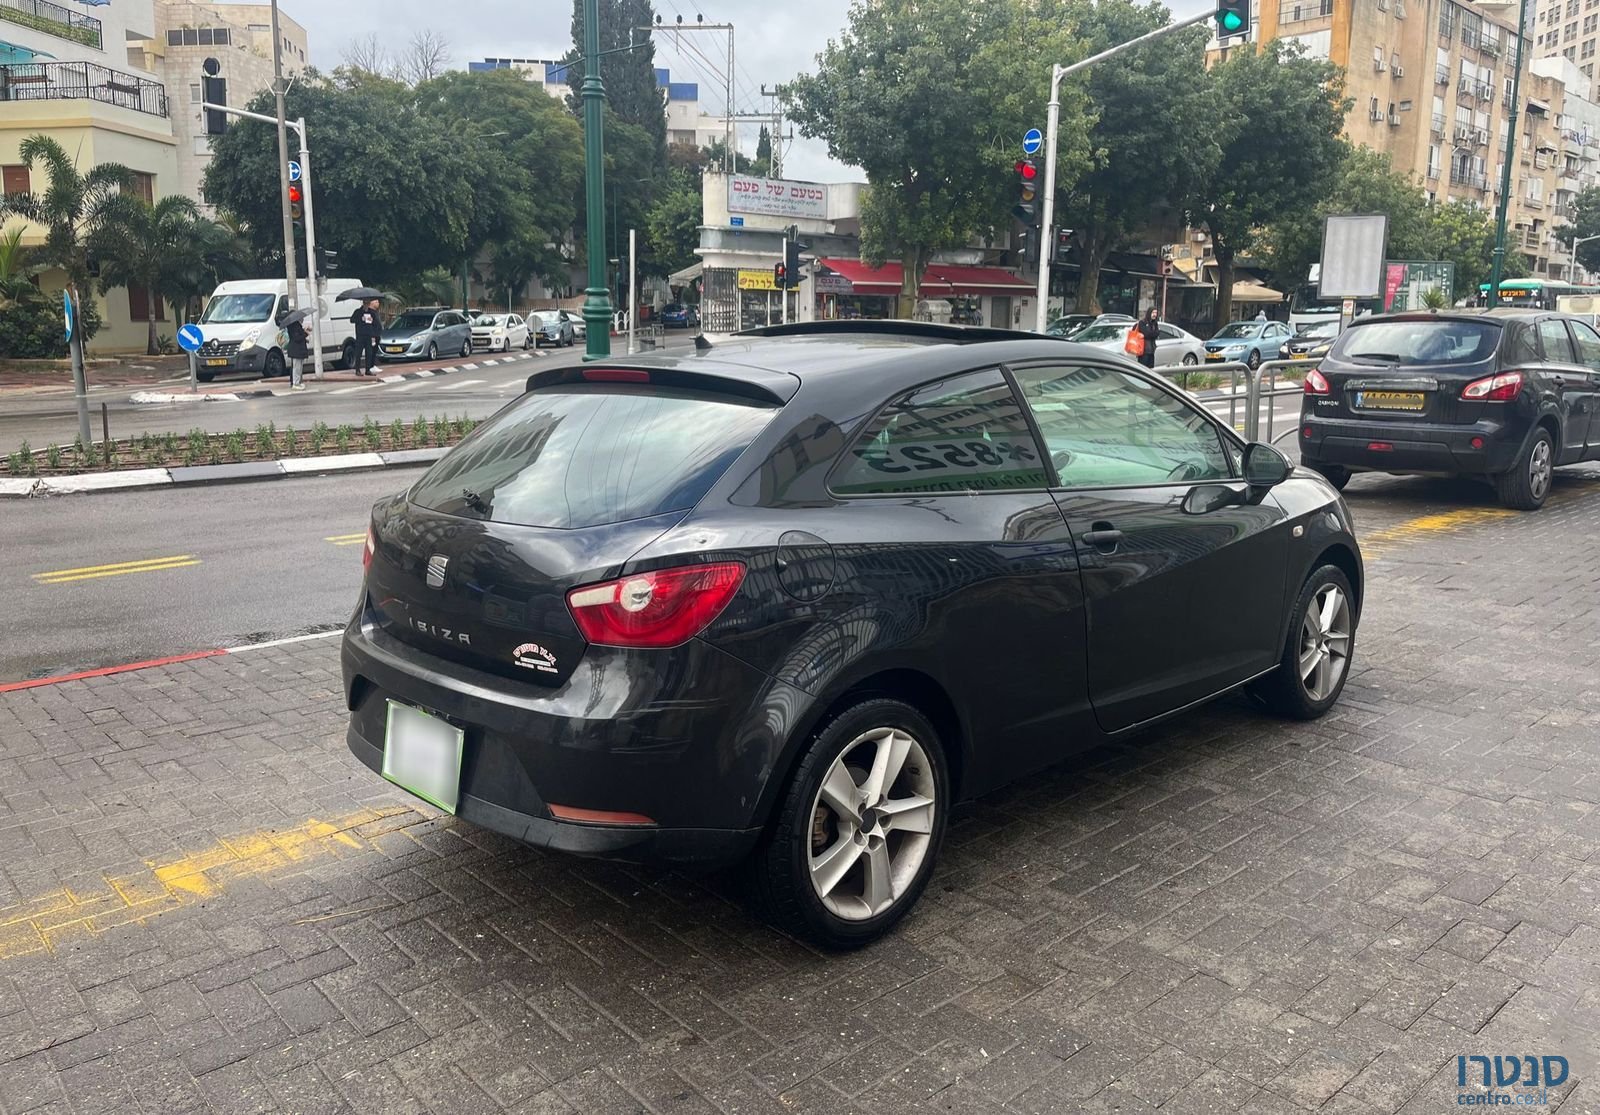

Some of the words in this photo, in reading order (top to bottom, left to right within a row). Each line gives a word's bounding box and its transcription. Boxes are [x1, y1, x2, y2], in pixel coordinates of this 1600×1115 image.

[733, 180, 760, 193] פעם
[765, 181, 785, 195] של
[790, 187, 824, 200] בטעם
[747, 277, 775, 289] לריה
[408, 616, 471, 645] IBIZA
